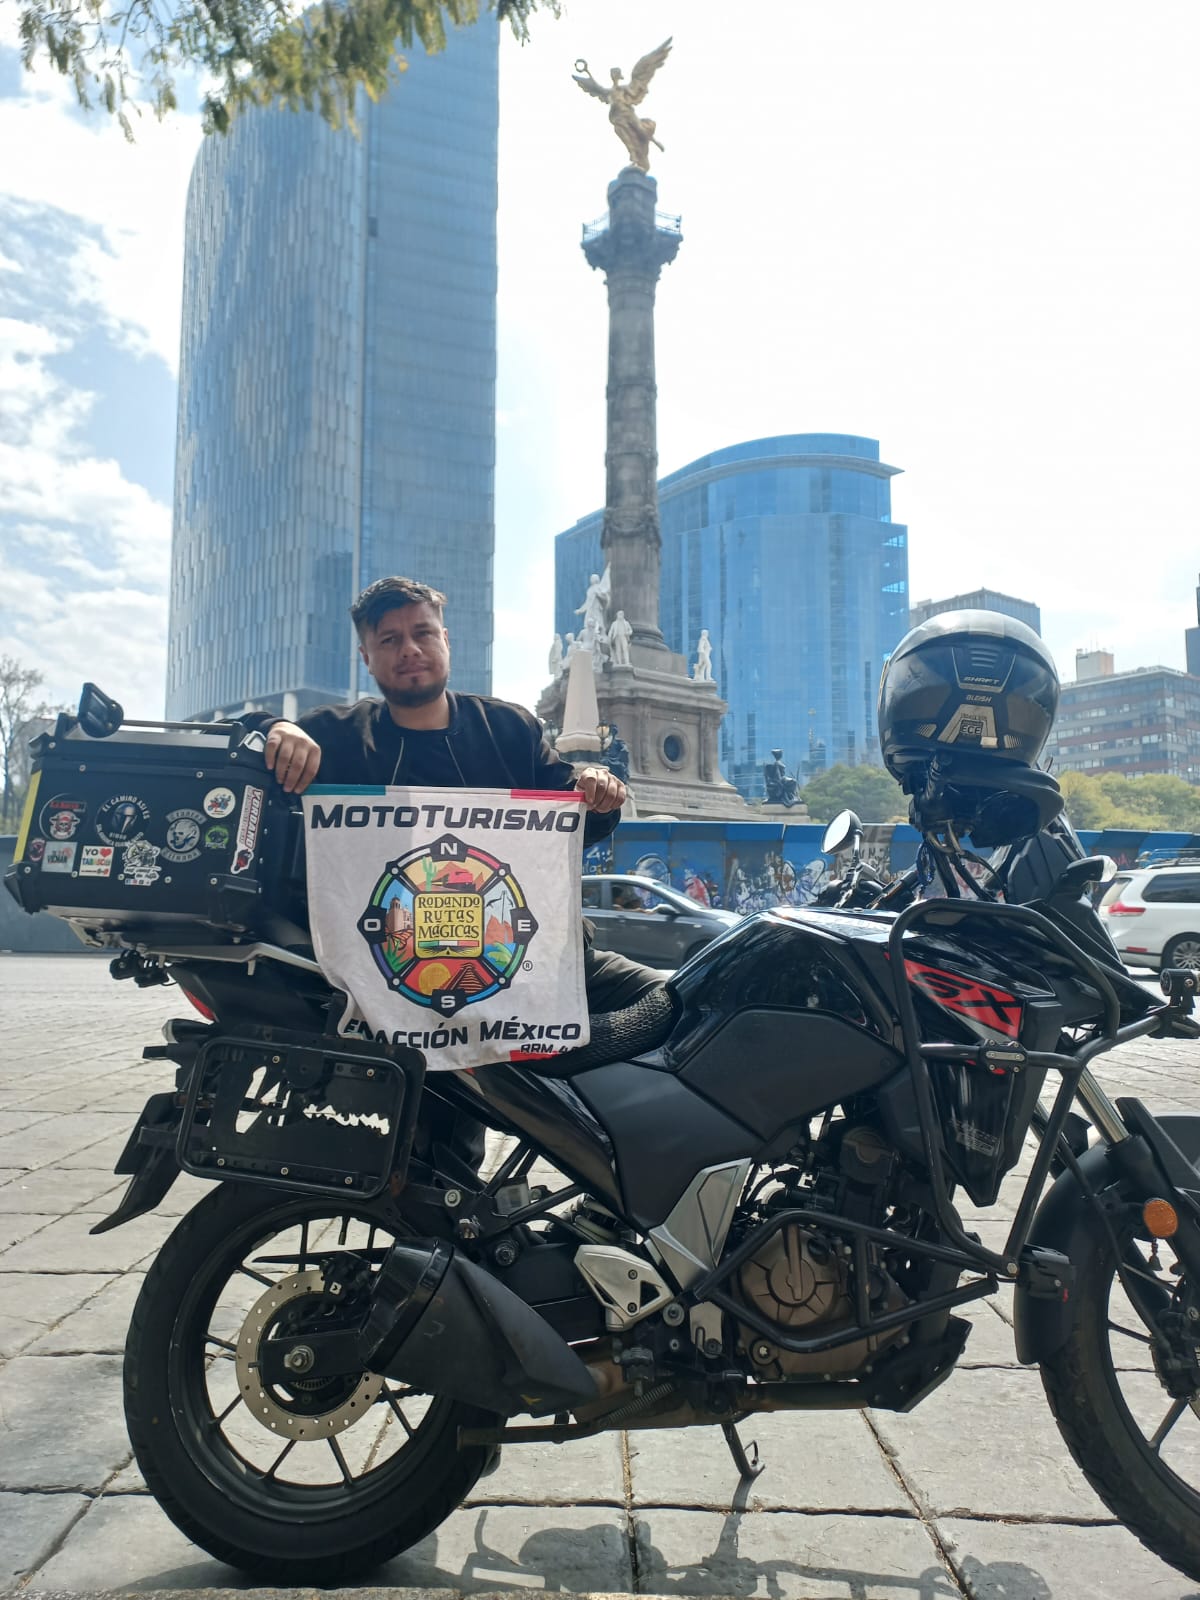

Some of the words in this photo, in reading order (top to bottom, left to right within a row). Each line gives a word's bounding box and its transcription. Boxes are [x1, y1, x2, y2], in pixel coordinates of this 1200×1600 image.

[84, 848, 99, 856] YO
[440, 842, 458, 856] N
[364, 918, 381, 932] O
[517, 919, 533, 932] E
[440, 995, 457, 1009] S
[480, 1016, 580, 1041] MÉXICO
